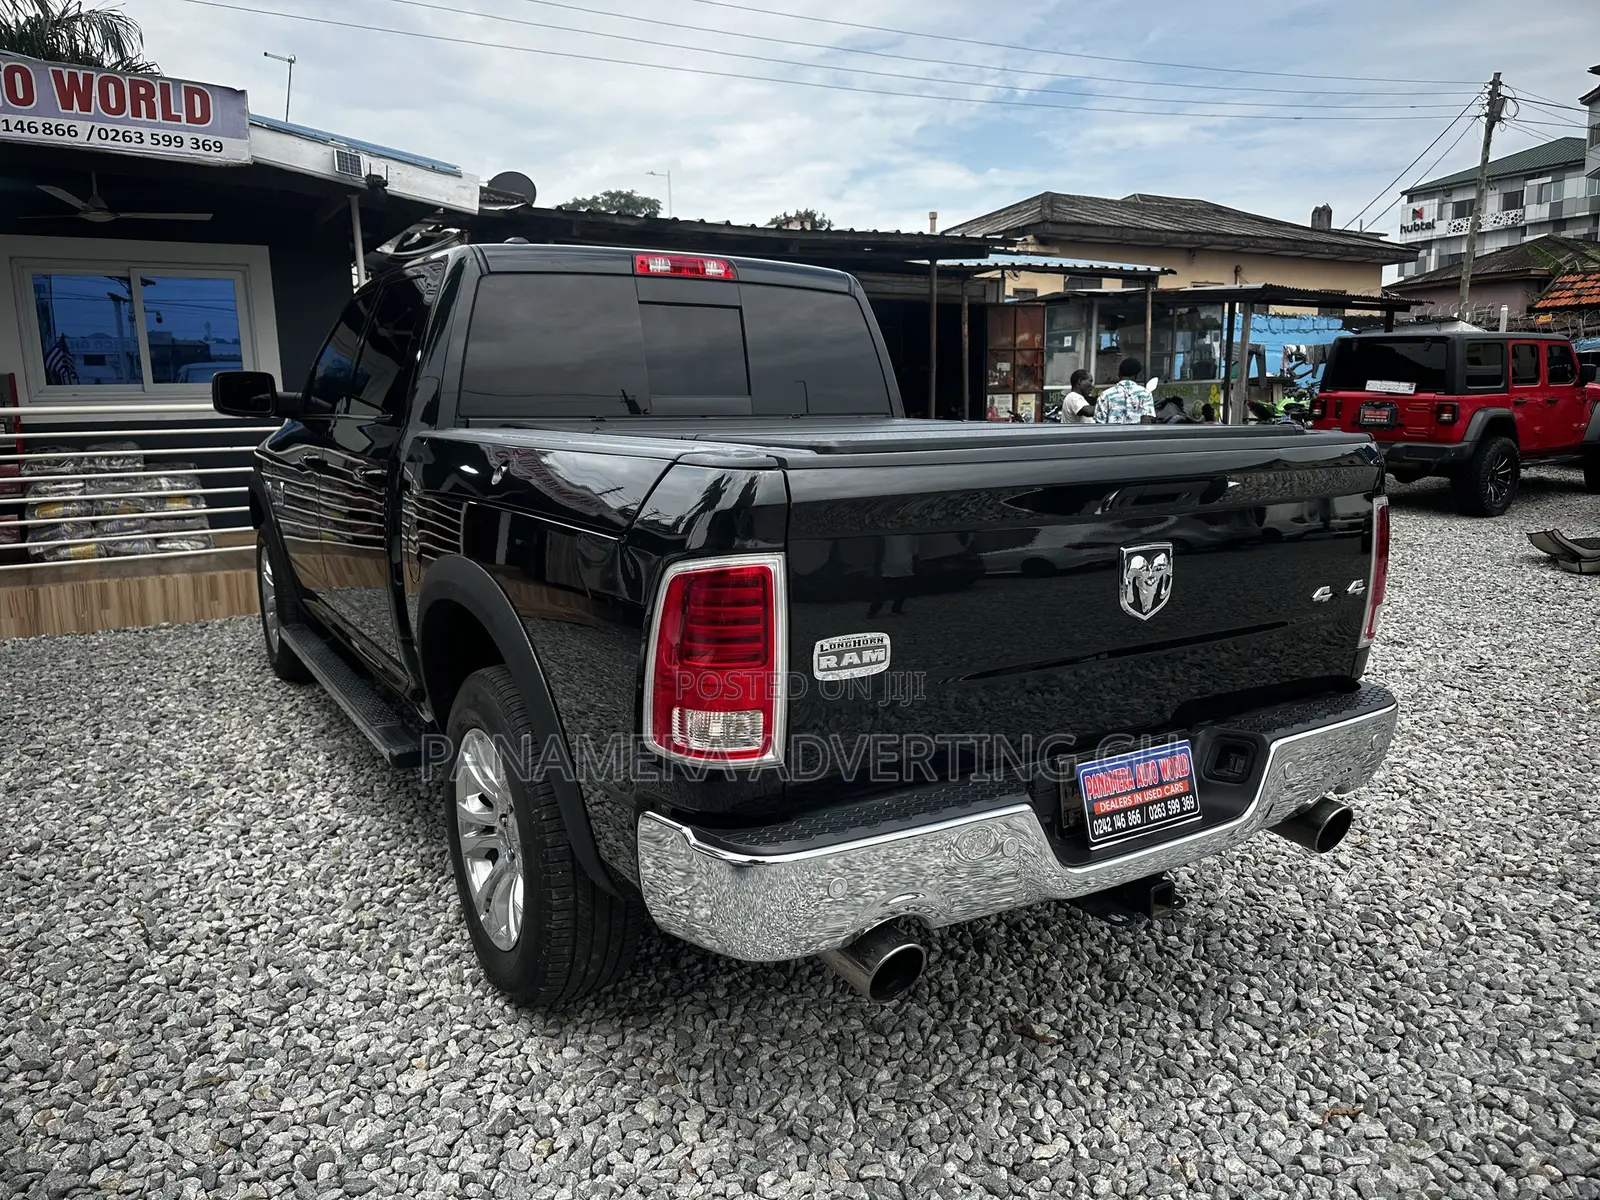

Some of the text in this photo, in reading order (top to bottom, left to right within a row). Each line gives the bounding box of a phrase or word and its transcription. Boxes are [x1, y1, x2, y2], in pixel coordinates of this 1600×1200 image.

[0, 62, 213, 128] O WORLD
[150, 133, 184, 148] 599
[190, 137, 224, 153] 369
[1400, 218, 1436, 234] hubtel
[819, 648, 886, 670] RAM
[1084, 753, 1190, 800] PANAMERA AUTO WORLD
[1100, 782, 1184, 812] DEALERS IN USED CARS
[1093, 817, 1112, 836] 0242
[1113, 813, 1126, 830] 146
[1127, 808, 1141, 826] 866
[1148, 802, 1166, 821] 0263
[1167, 798, 1180, 815] 599
[1181, 795, 1195, 811] 369
